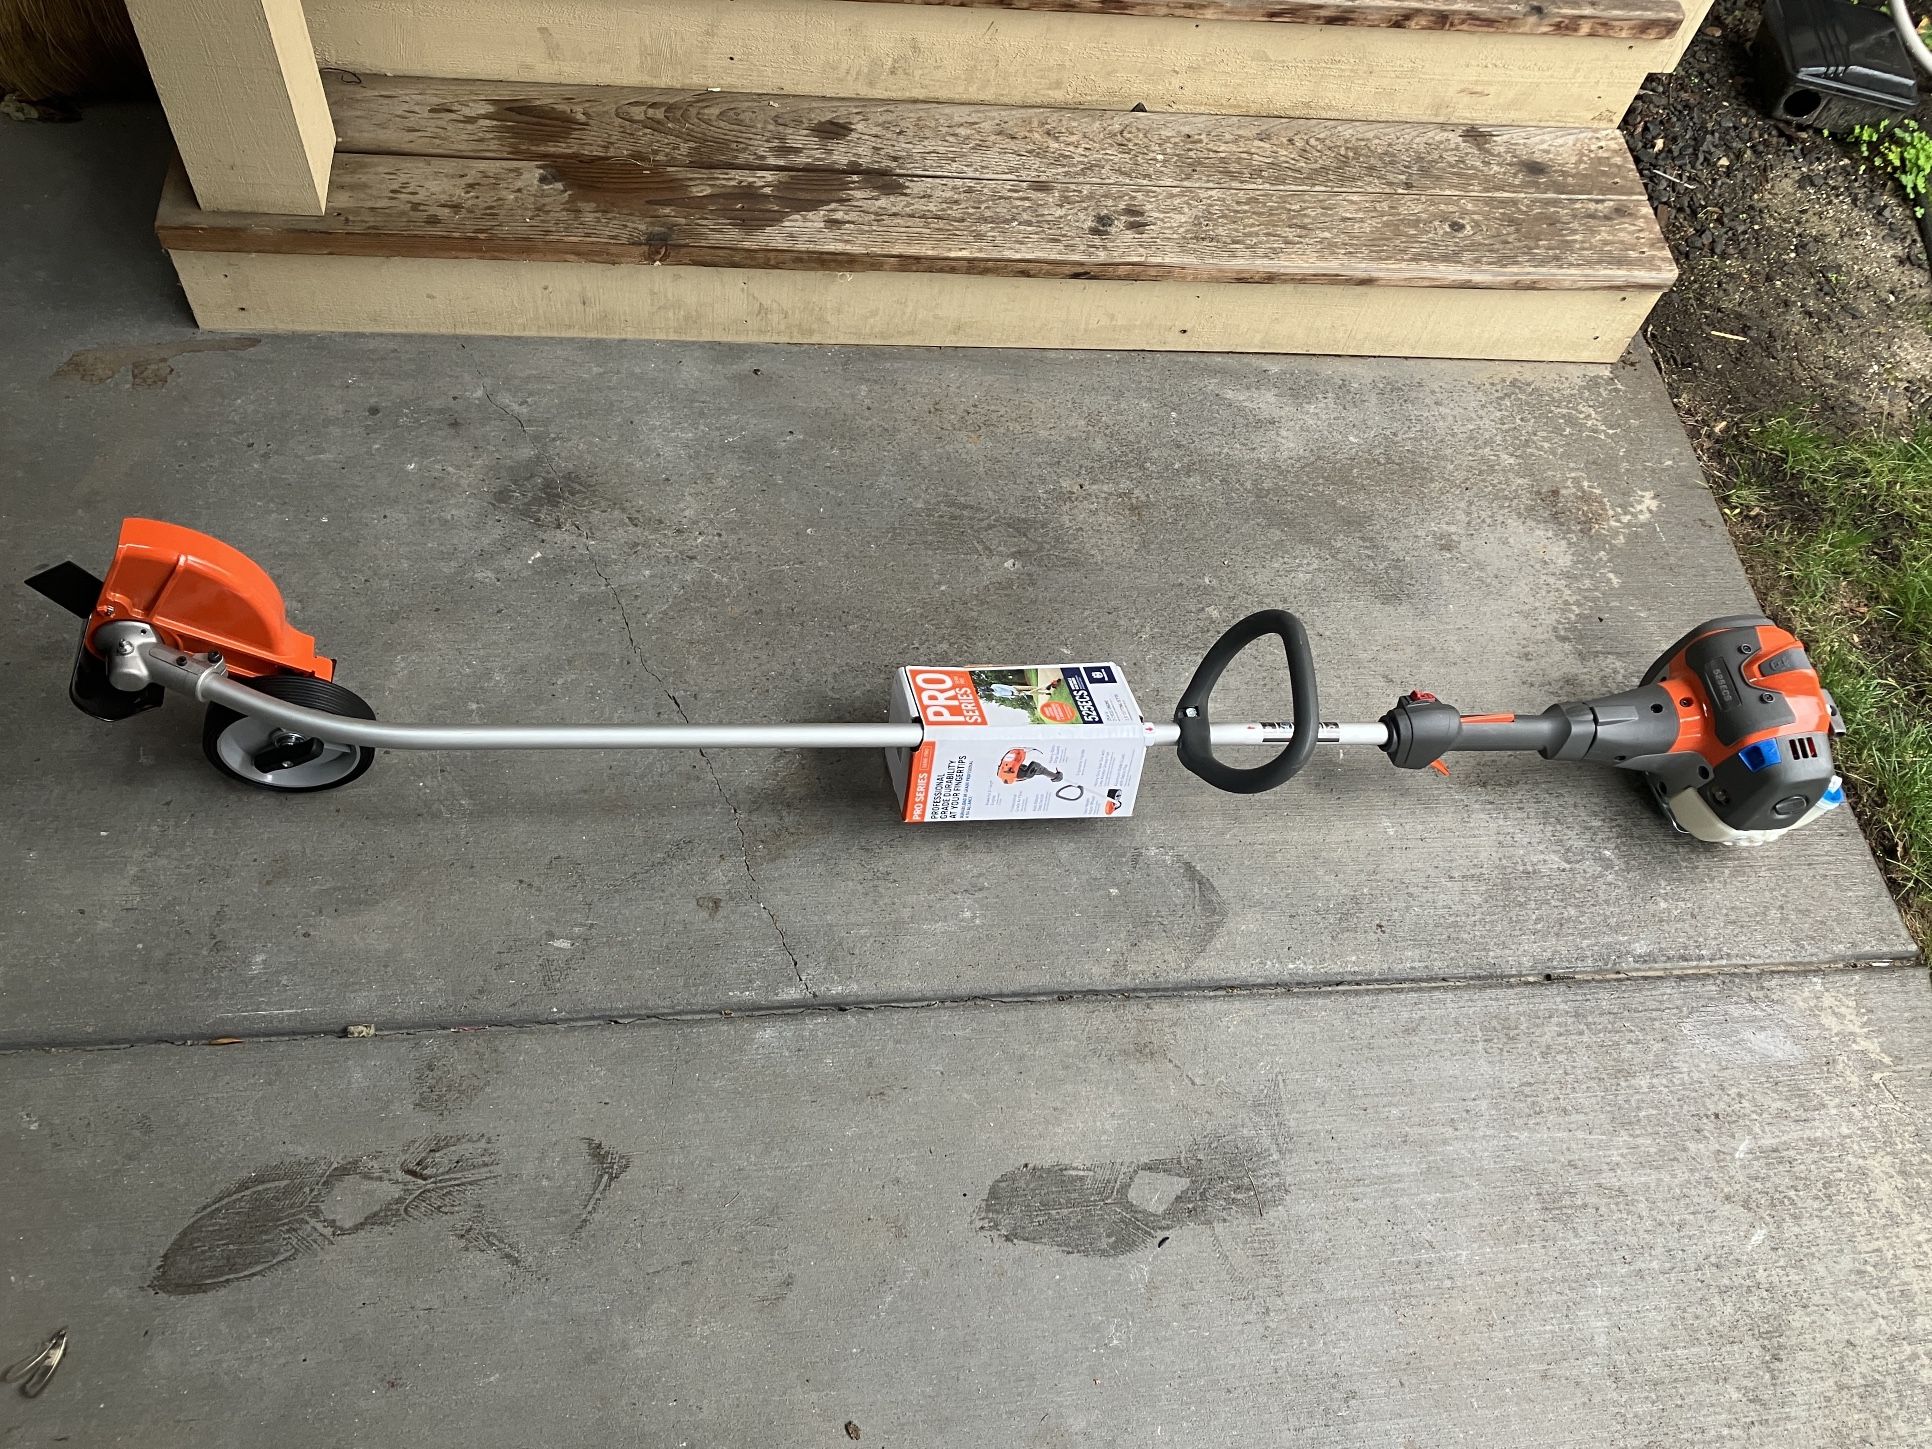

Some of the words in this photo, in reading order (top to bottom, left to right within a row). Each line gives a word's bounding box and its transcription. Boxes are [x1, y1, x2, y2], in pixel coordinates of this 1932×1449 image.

[915, 673, 964, 721] PRO
[955, 687, 982, 723] SERIES
[1073, 690, 1099, 722] 525ECS
[915, 772, 928, 802] SERIES
[943, 759, 957, 797] DURABILITY
[953, 755, 967, 792] FINGERTIPS
[912, 804, 924, 820] PRO
[931, 773, 946, 820] PROFESSIONAL
[940, 798, 951, 820] GRADE
[950, 792, 961, 810] YOUR
[949, 811, 957, 819] AT
